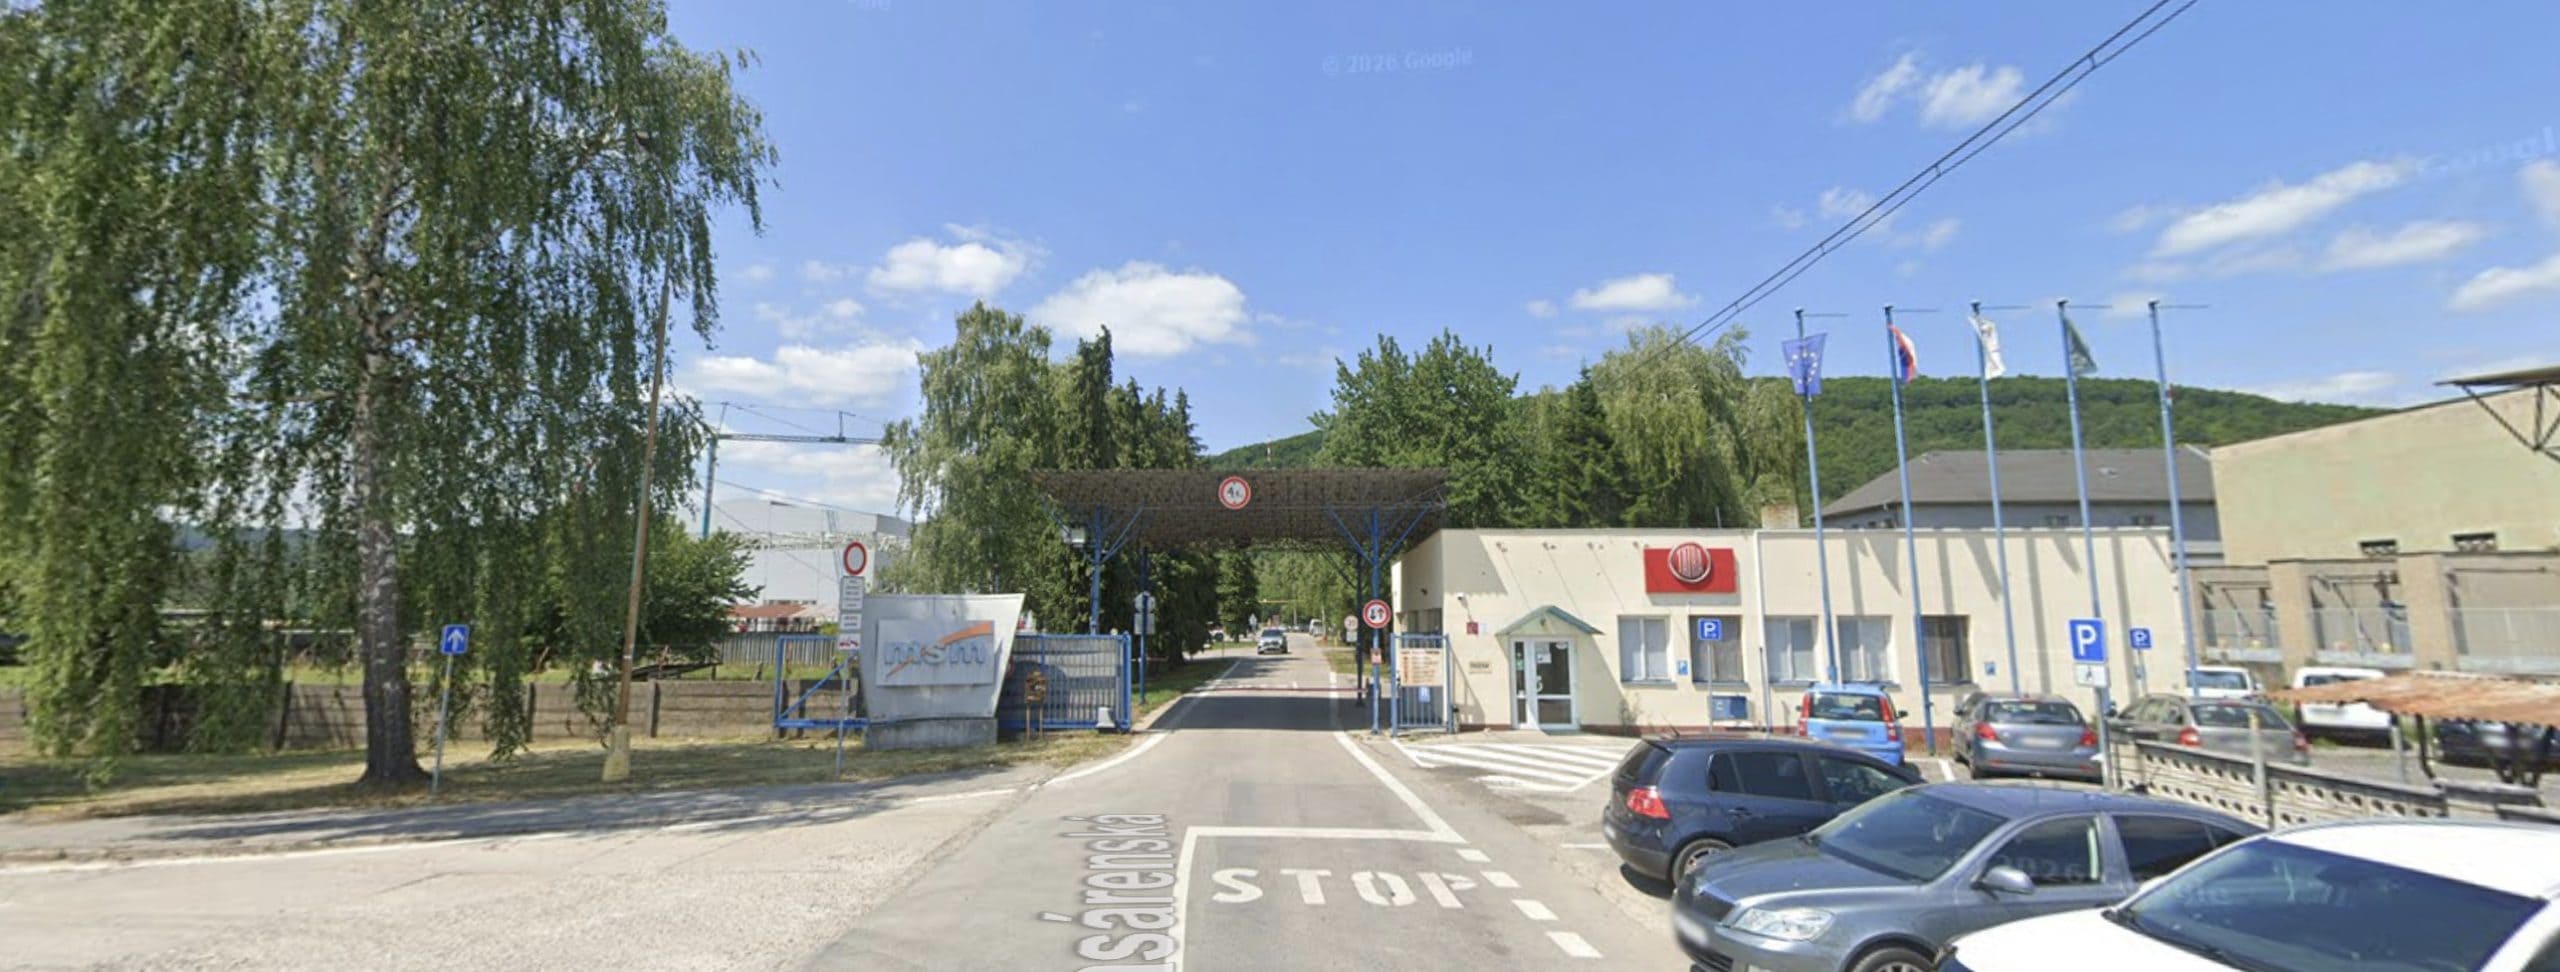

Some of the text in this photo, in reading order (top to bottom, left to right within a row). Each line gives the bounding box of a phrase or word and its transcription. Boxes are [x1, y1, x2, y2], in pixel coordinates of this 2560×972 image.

[1703, 622, 1716, 638] P
[2076, 624, 2096, 656] P
[884, 641, 986, 665] msm
[1212, 868, 1477, 908] STOP
